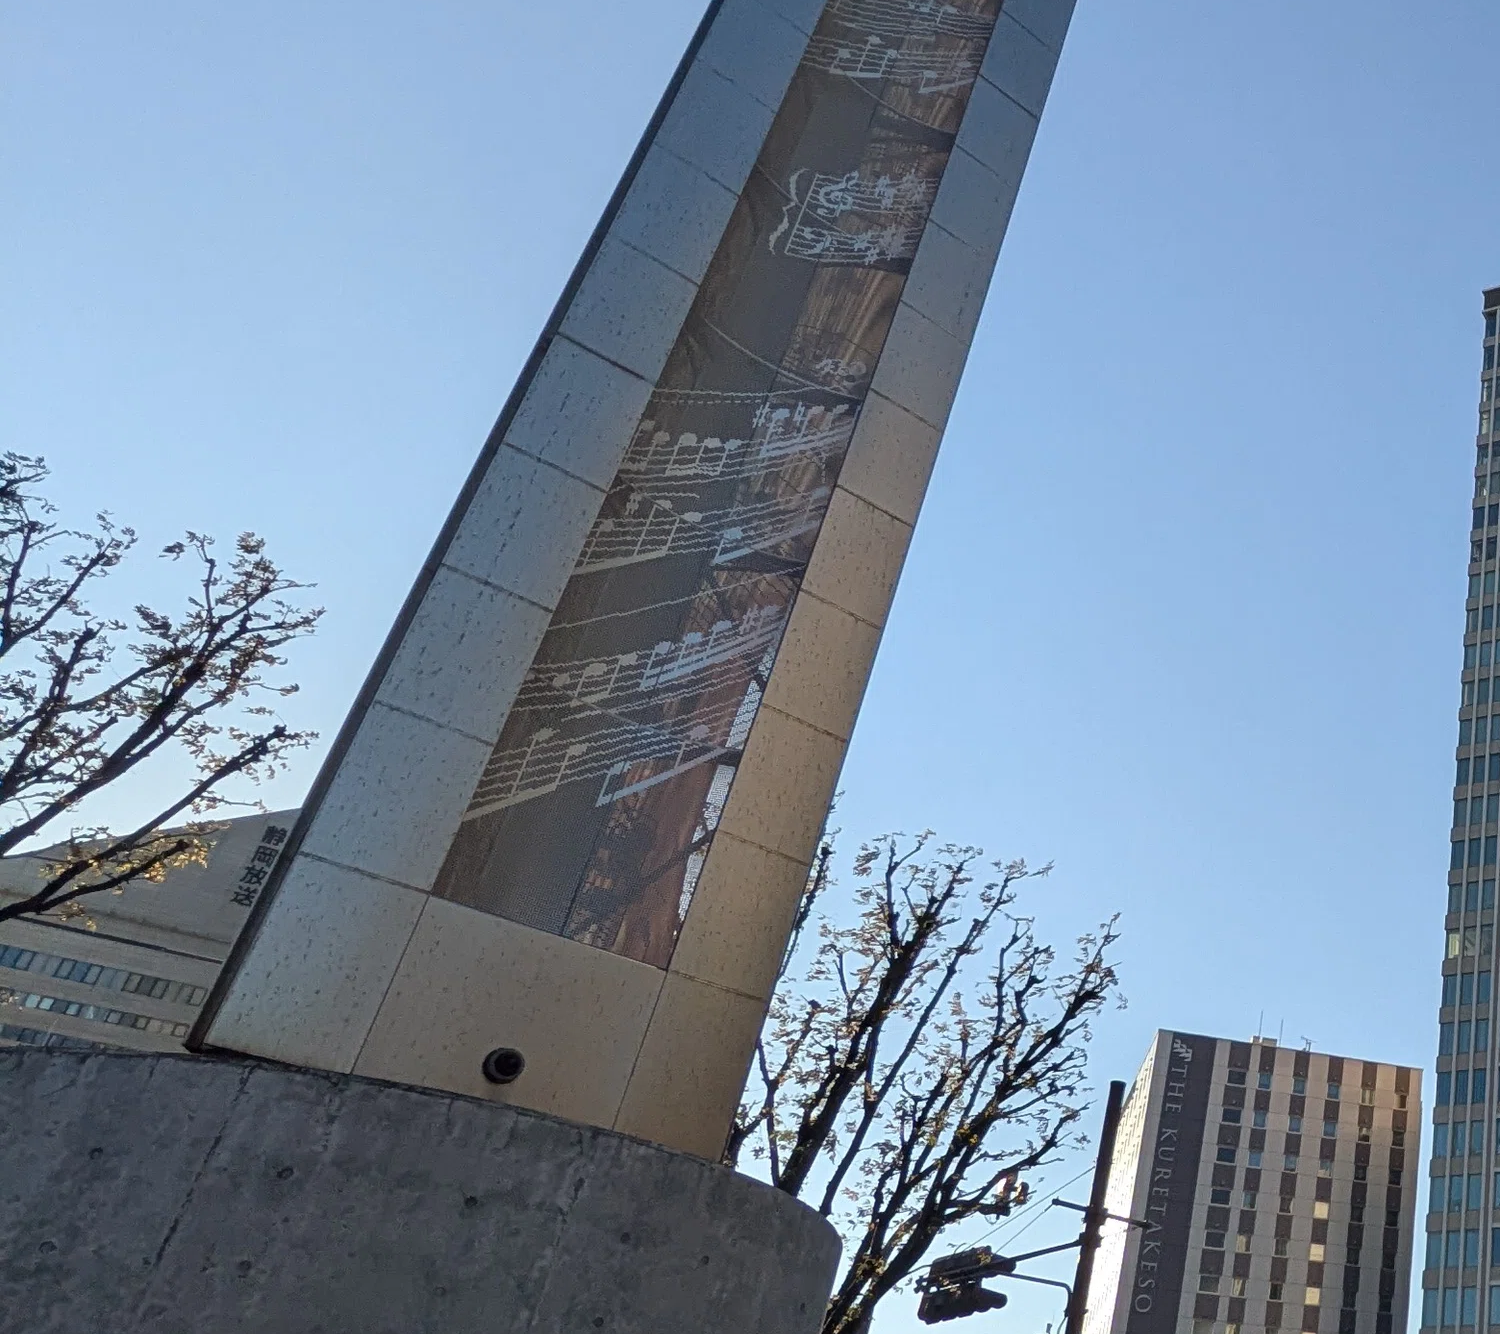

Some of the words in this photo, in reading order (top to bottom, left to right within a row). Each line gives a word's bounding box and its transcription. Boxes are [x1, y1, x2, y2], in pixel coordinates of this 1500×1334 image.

[229, 825, 288, 907] 静岡放送
[1164, 1064, 1188, 1113] THE
[1134, 1127, 1179, 1313] KURETAKESO
